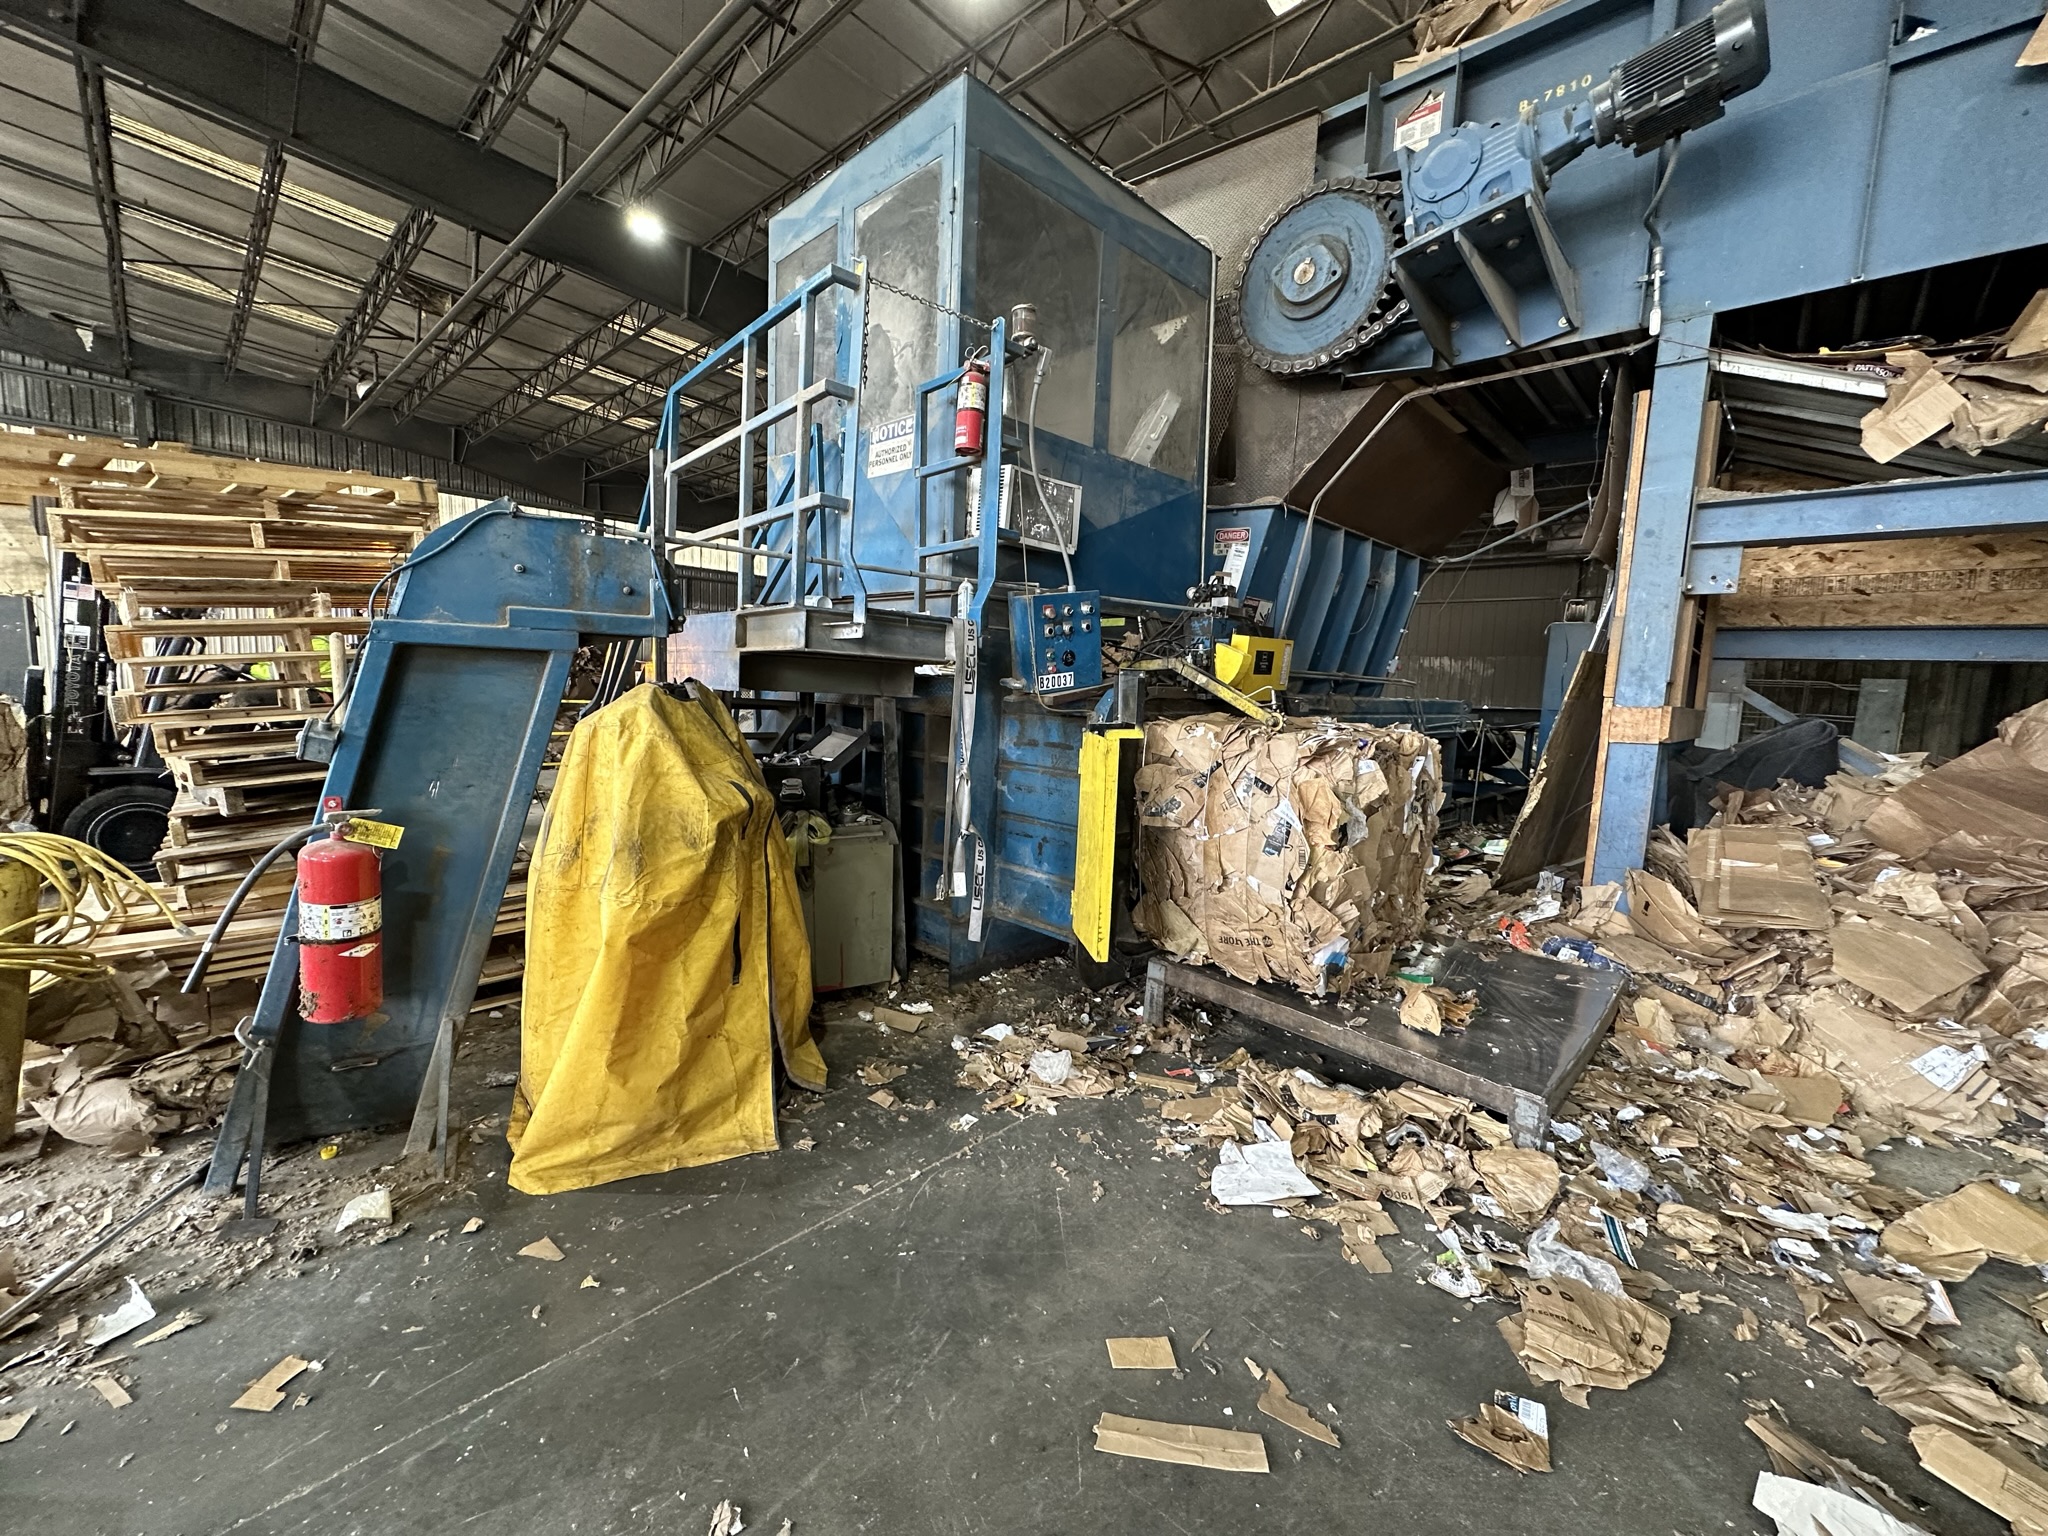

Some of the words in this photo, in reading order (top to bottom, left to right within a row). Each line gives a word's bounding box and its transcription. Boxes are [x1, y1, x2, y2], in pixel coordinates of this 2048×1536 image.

[871, 418, 913, 444] NOTICE
[875, 444, 907, 458] AUTHORIZED
[869, 454, 898, 468] PERSONNEL
[899, 451, 913, 461] ONLY
[1219, 531, 1246, 540] DANGER
[64, 653, 82, 707] TOYOTA
[1040, 673, 1073, 689] B20037
[1244, 937, 1261, 947] THE
